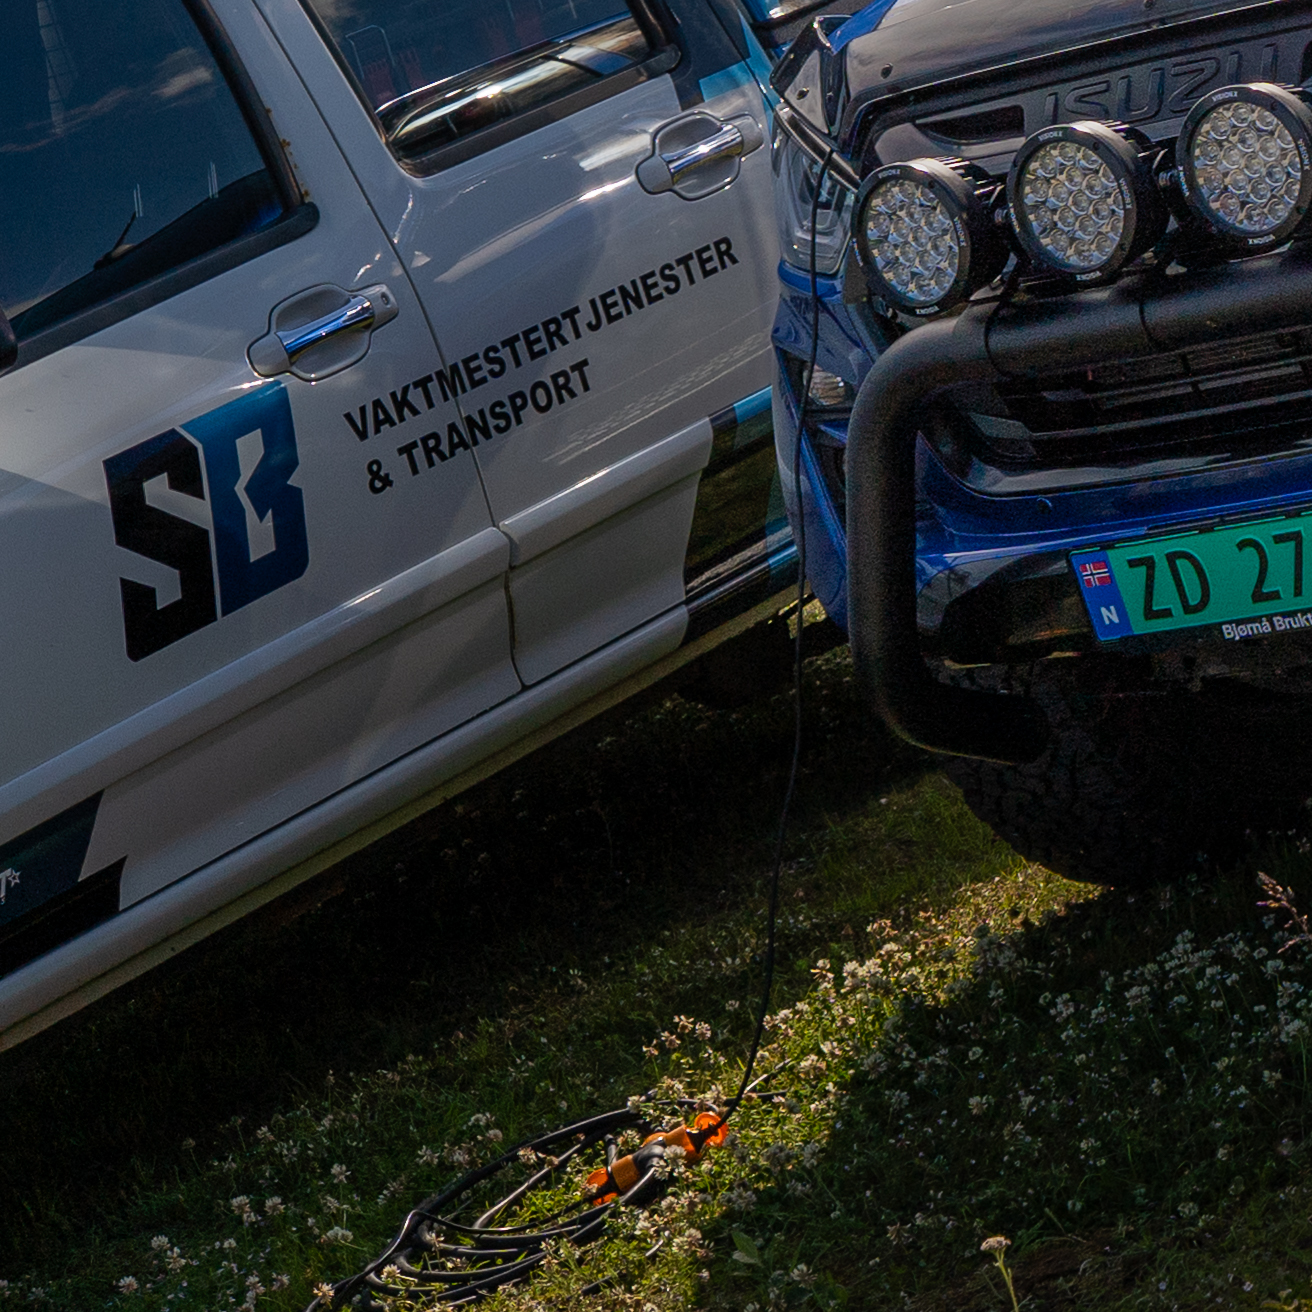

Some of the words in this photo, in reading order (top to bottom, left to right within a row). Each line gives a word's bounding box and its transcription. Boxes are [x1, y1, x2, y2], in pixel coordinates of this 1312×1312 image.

[342, 236, 740, 443] VAKTMESTERTJENESTER
[366, 458, 394, 496] &
[396, 357, 592, 478] TRANSPORT
[102, 379, 310, 663] SB
[1099, 604, 1120, 625] N
[1126, 548, 1211, 622] ZD
[1222, 618, 1272, 640] Bjørnå
